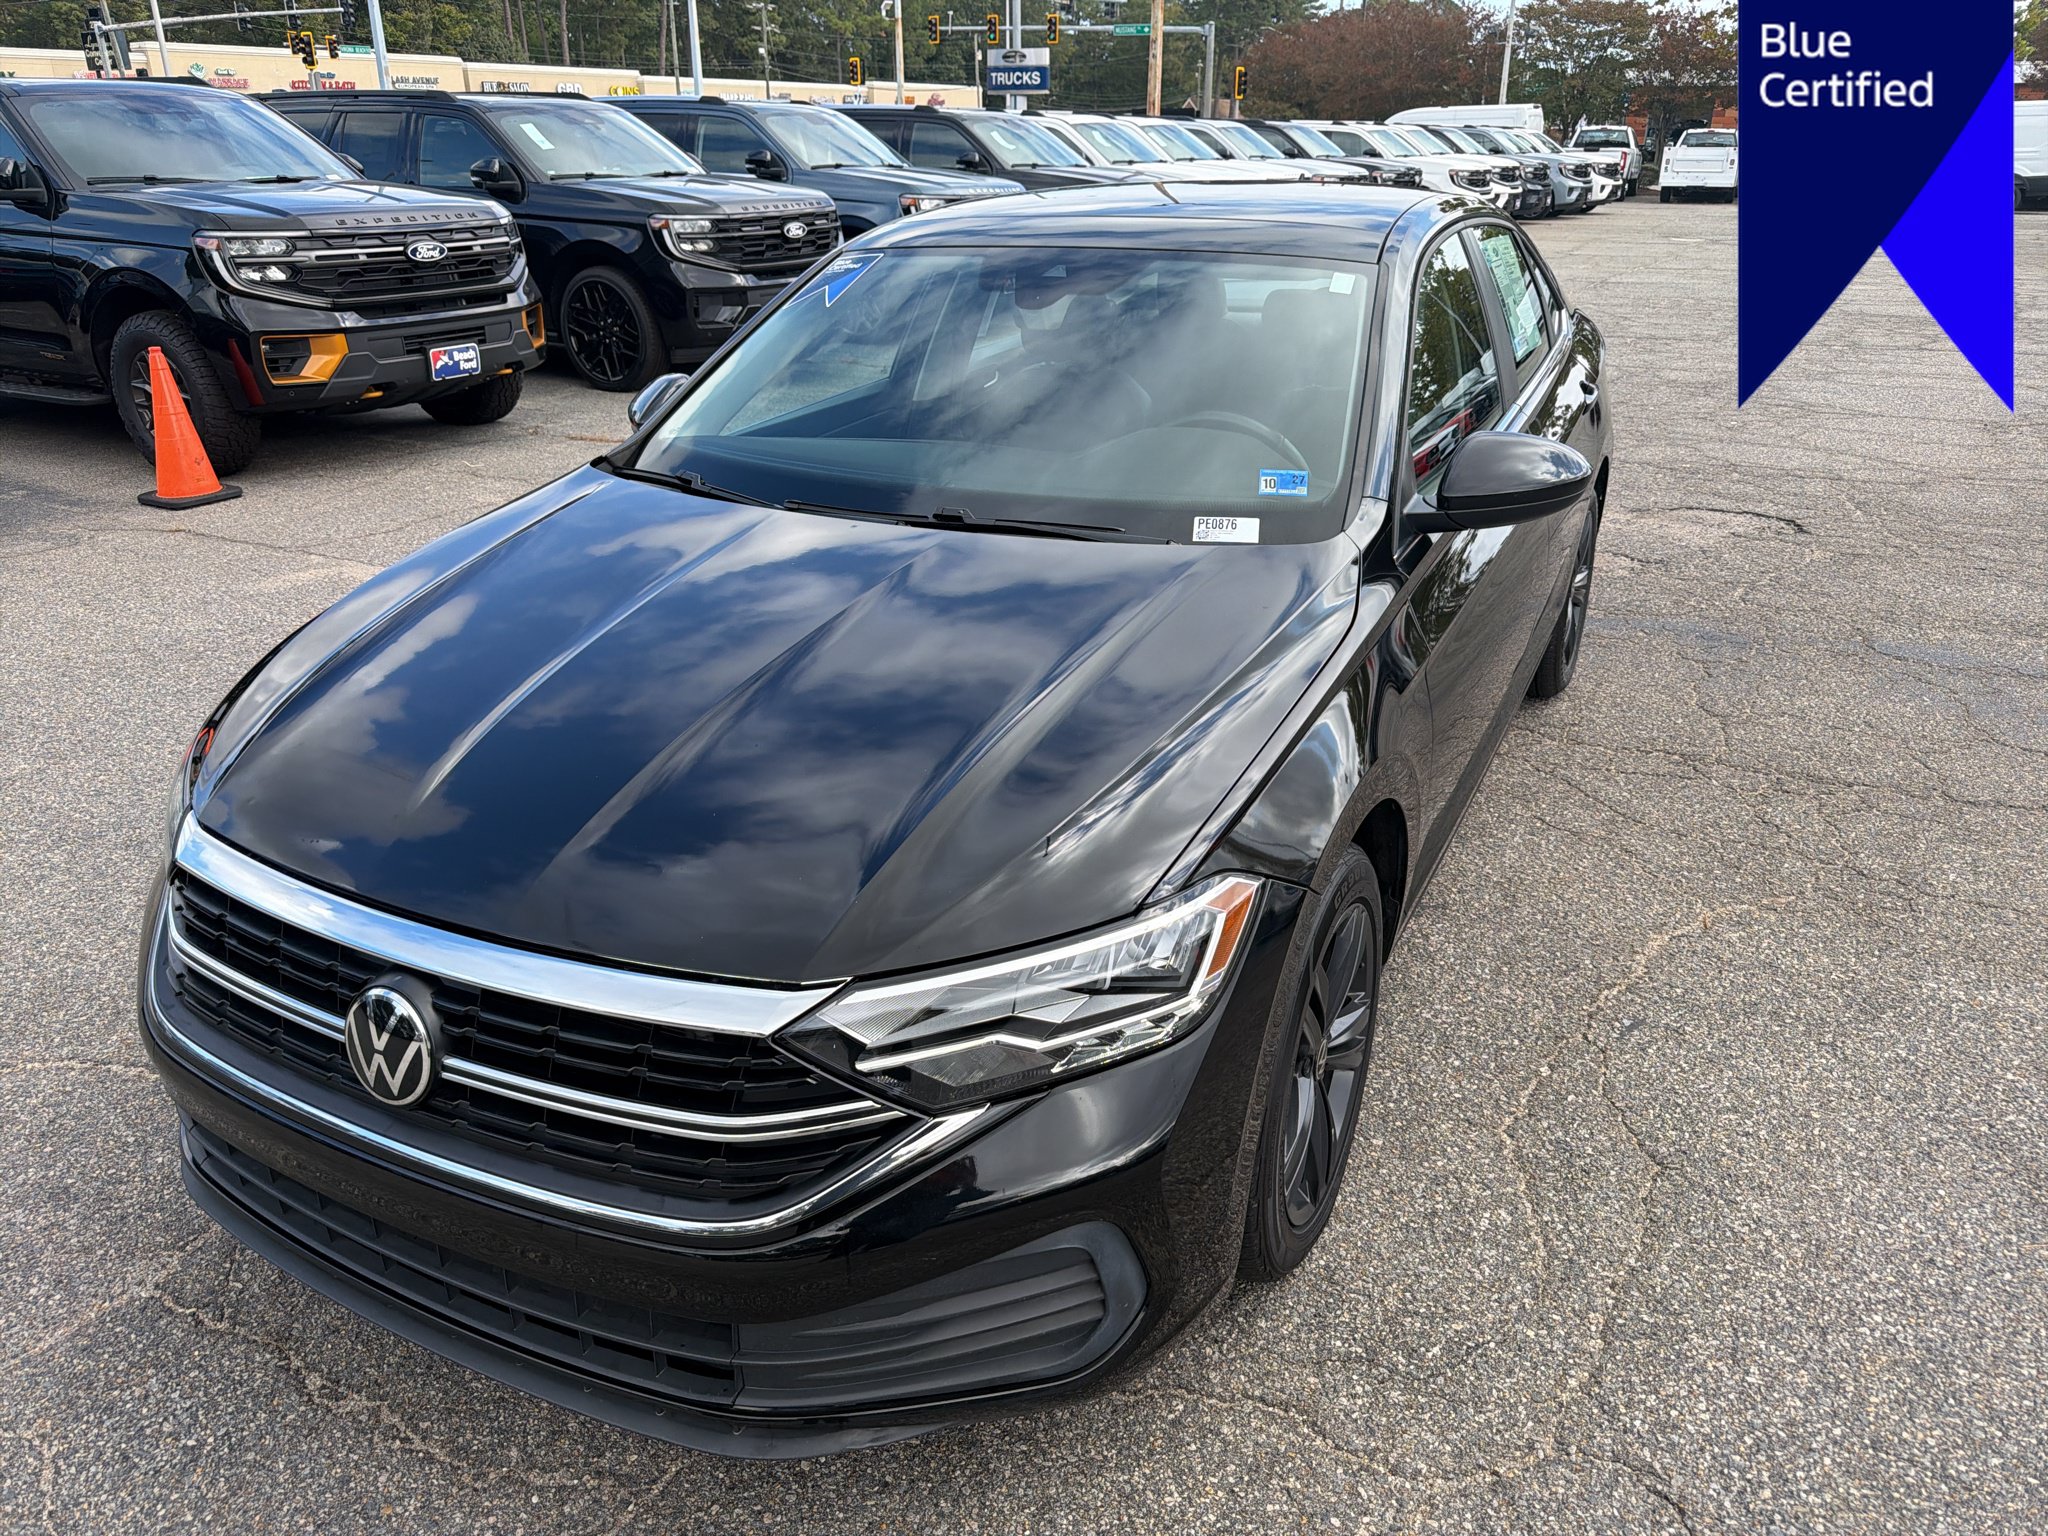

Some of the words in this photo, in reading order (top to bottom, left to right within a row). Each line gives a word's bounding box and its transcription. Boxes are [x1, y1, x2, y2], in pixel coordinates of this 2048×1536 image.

[412, 76, 440, 85] AVENUE
[990, 71, 1041, 85] TRUCKS
[415, 244, 441, 260] Ford
[453, 349, 476, 361] Beach
[460, 358, 477, 370] Ford
[1263, 478, 1276, 489] 10
[1292, 474, 1305, 485] 27
[1198, 518, 1237, 530] PE0876
